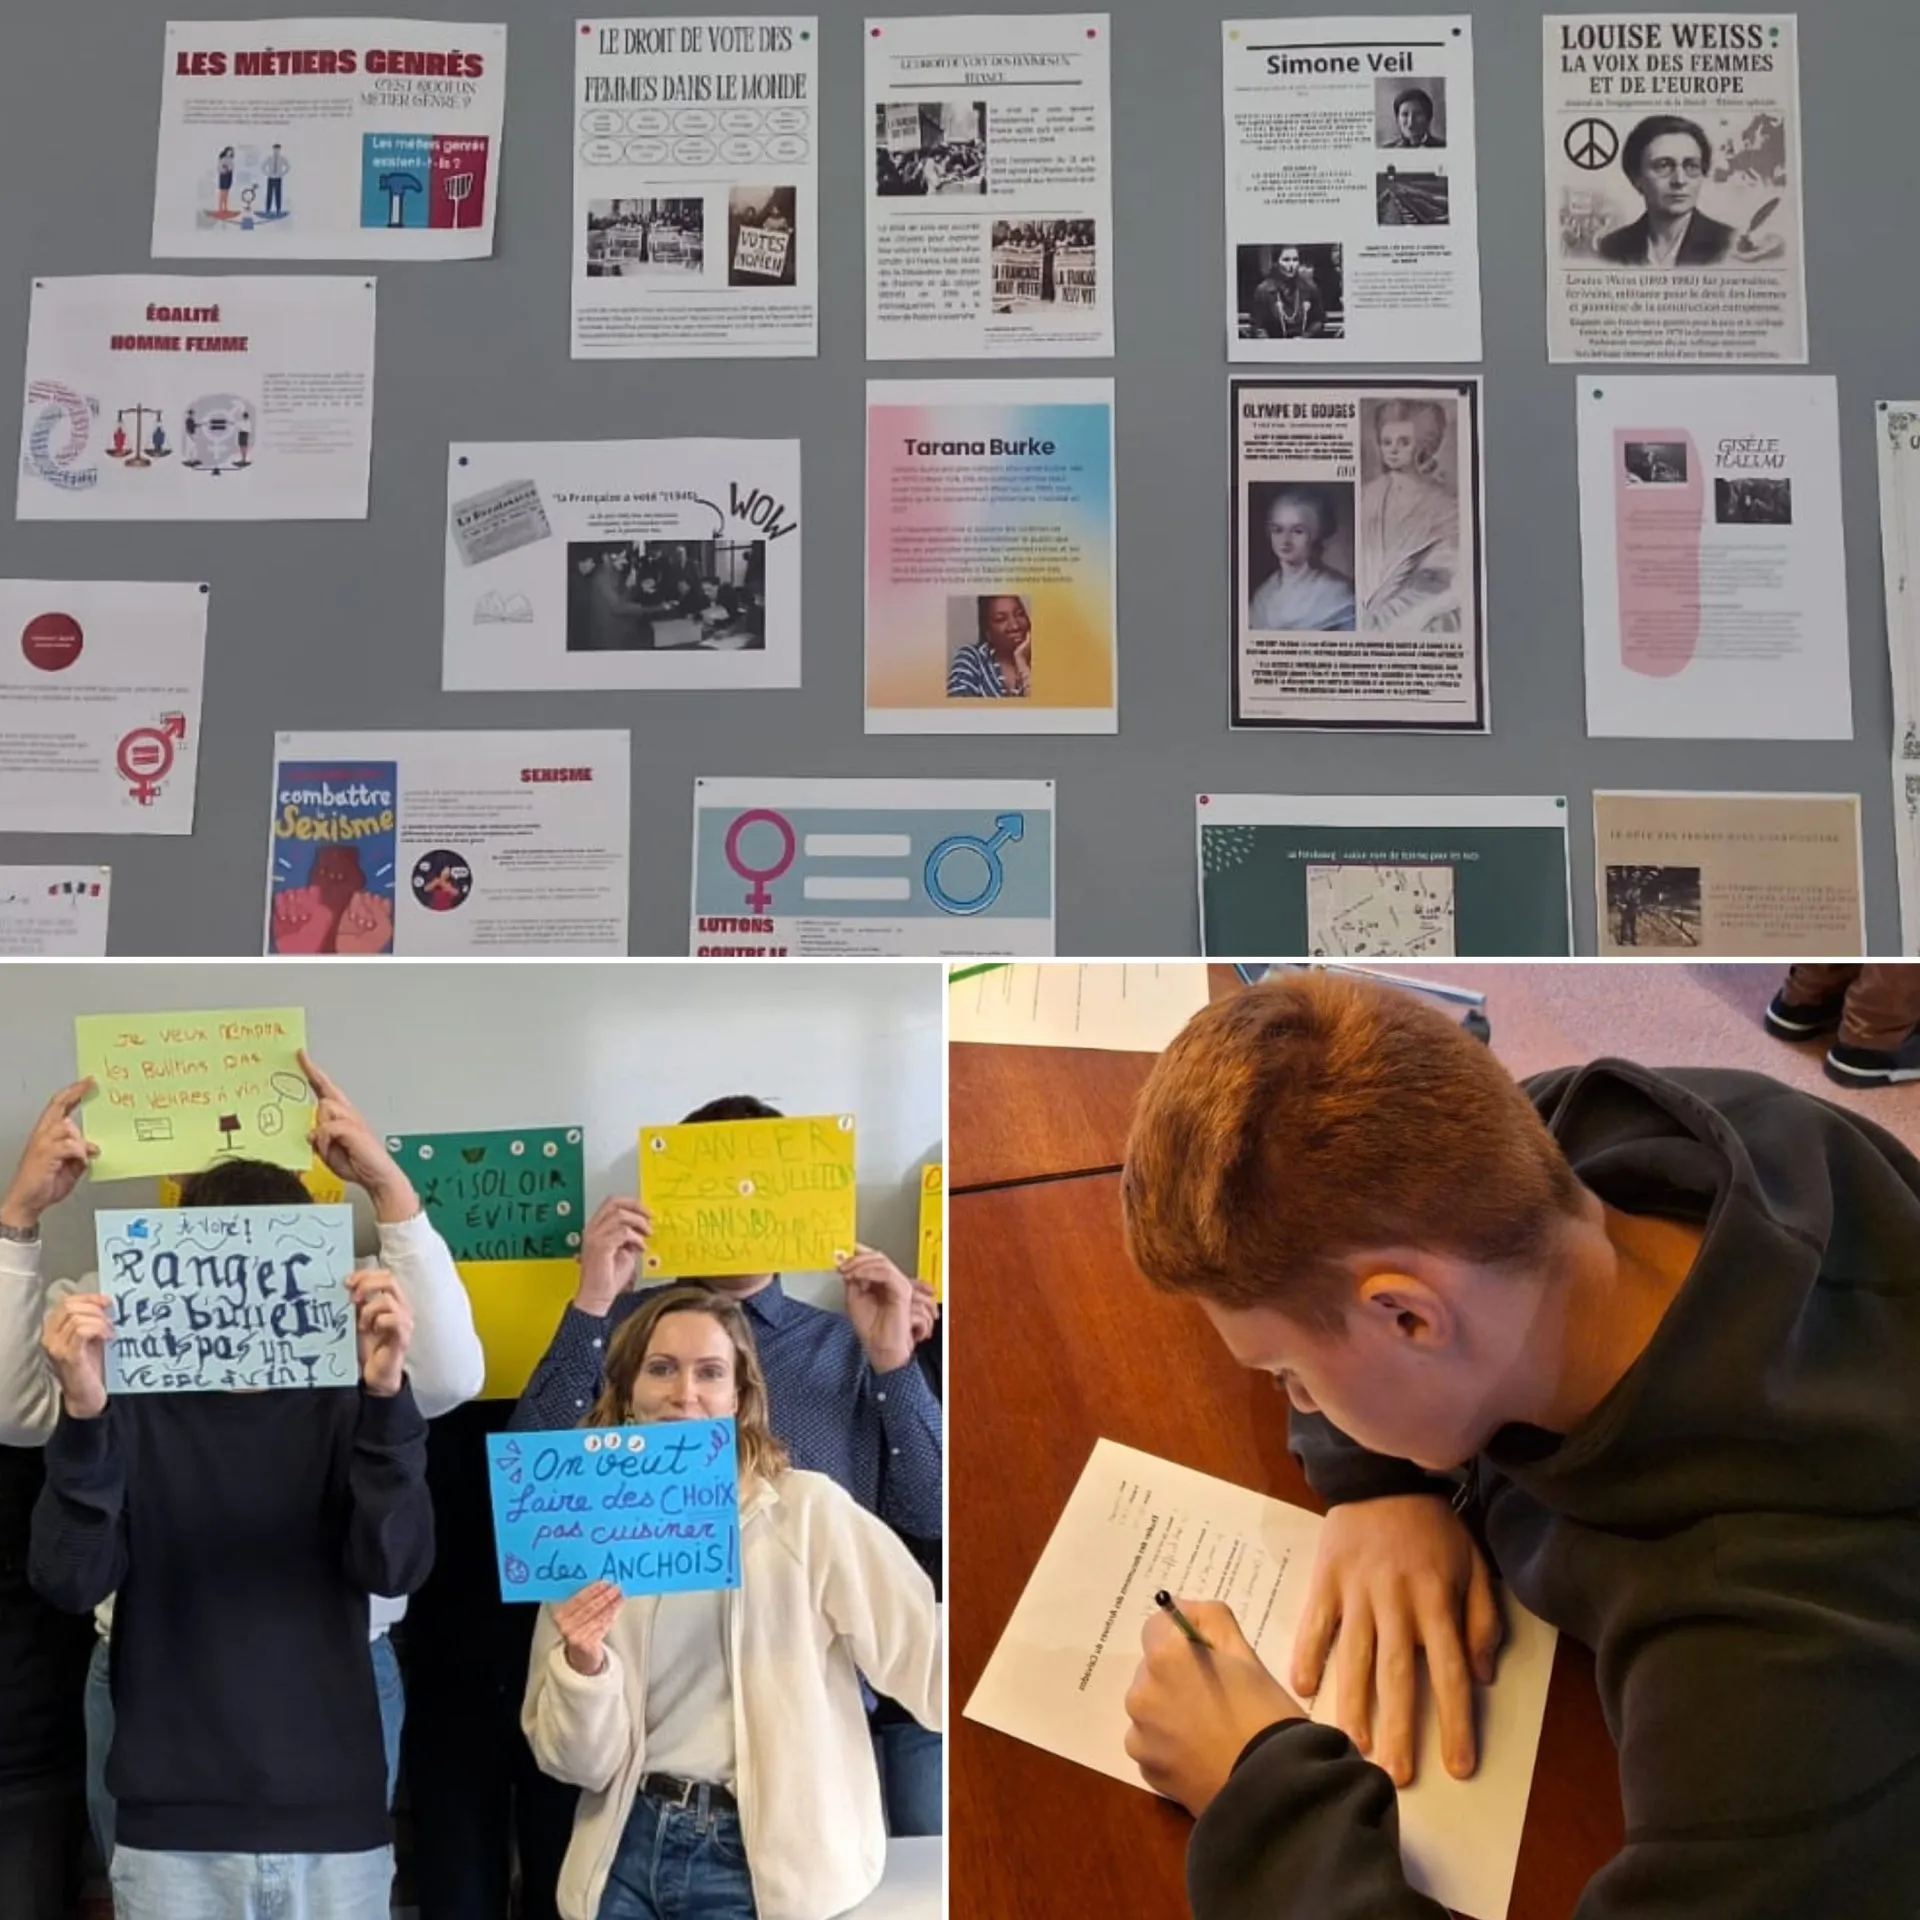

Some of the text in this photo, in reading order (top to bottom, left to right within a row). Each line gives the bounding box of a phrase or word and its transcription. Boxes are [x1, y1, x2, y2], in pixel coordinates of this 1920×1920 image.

[600, 26, 793, 54] LE DROIT DE VOTE DES
[1561, 24, 1662, 50] LOUISE
[1672, 23, 1763, 49] WEISS
[176, 47, 484, 77] LES MÉTIERS GENRÉS
[1267, 52, 1414, 75] Simone Veil
[1562, 54, 1773, 73] LA VOIX DES FEMMES
[585, 72, 807, 102] FEMMES DANS LE MONDE
[1590, 76, 1744, 94] ET DE L'EUROPE
[146, 302, 220, 322] ÉGALITÉ
[110, 335, 248, 352] HOMME FEMME
[1243, 402, 1356, 419] OLYMPE DE GOUGES
[904, 437, 1055, 456] Tarana Burke
[729, 482, 797, 540] WOW
[520, 767, 593, 783] SEXISME
[280, 781, 392, 807] combattre
[274, 804, 395, 842] Sexisme
[698, 917, 774, 934] LUTTONS
[533, 1434, 702, 1483] On veut
[506, 1476, 737, 1524] faire des CHOIX
[532, 1518, 716, 1550] pas cuisiner
[535, 1550, 588, 1582] des
